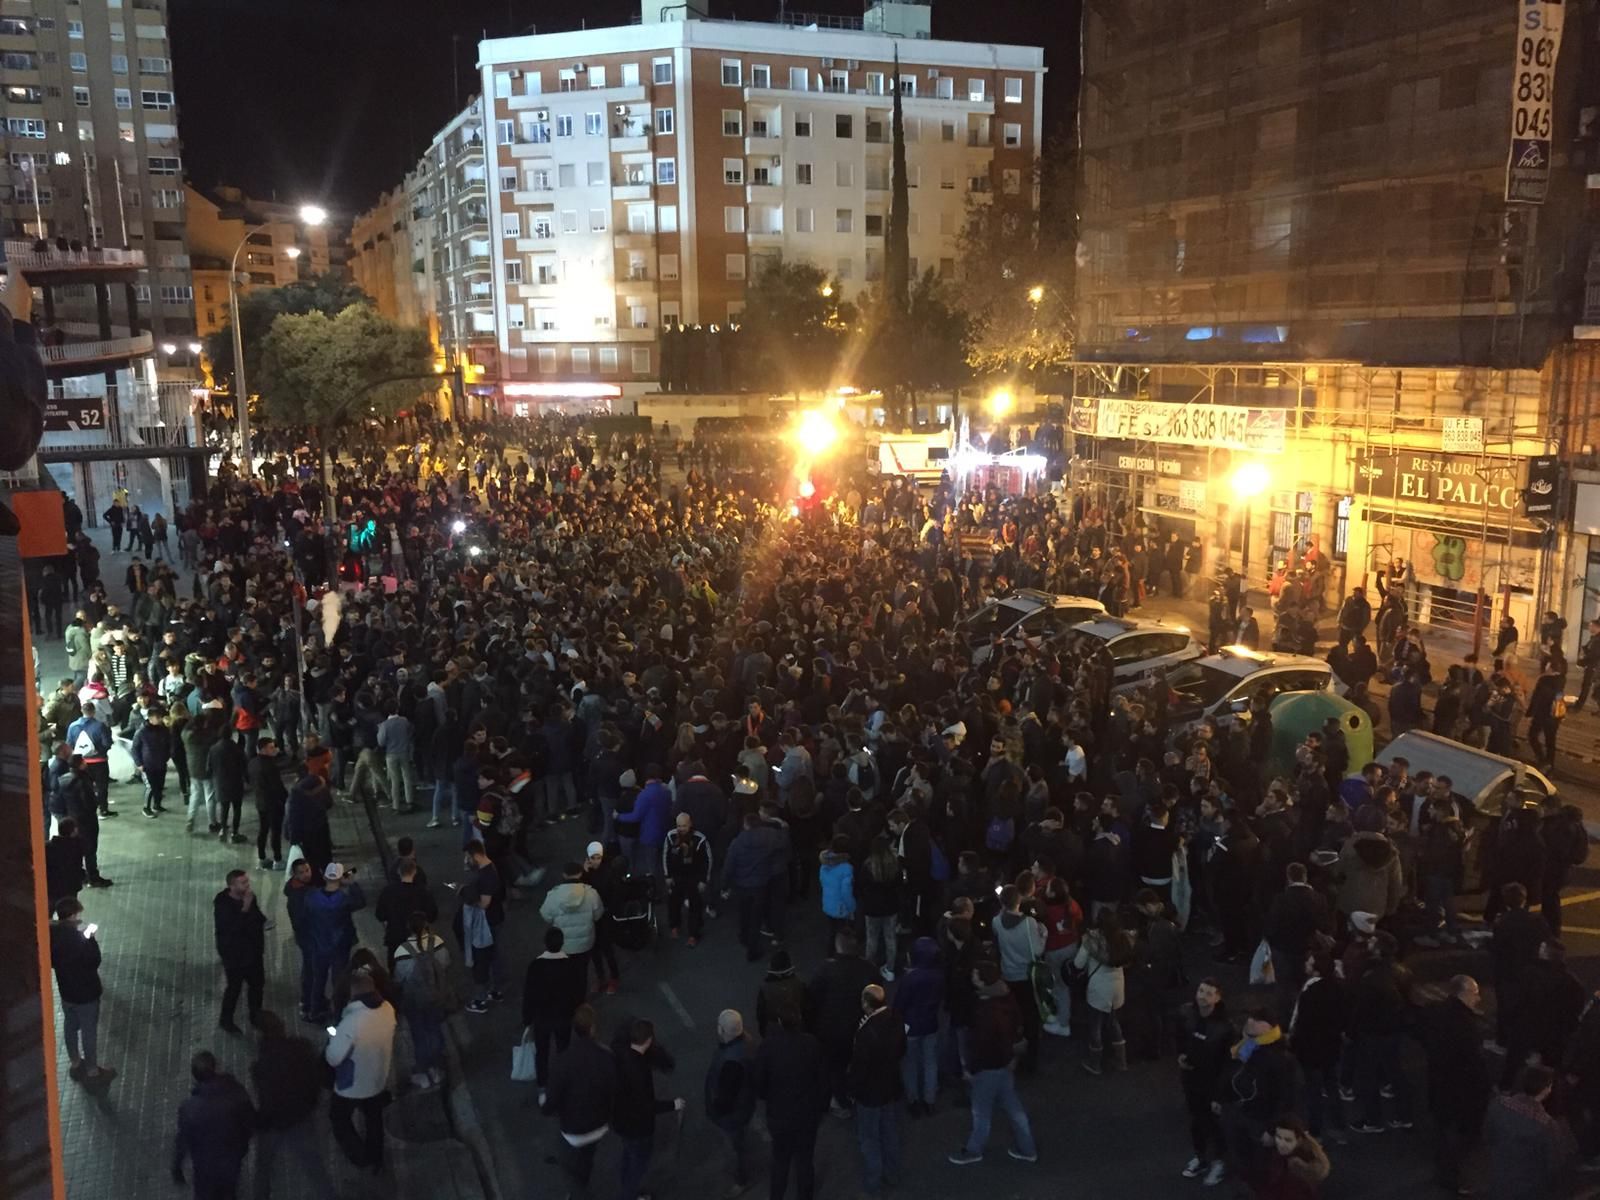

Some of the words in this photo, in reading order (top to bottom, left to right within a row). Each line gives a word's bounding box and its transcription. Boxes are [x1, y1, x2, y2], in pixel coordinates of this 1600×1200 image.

[1515, 108, 1550, 138] 045
[80, 409, 100, 426] 52
[1192, 409, 1216, 440] 838
[1220, 411, 1247, 442] 045
[1401, 473, 1429, 499] EL
[1436, 477, 1520, 509] PALCO
